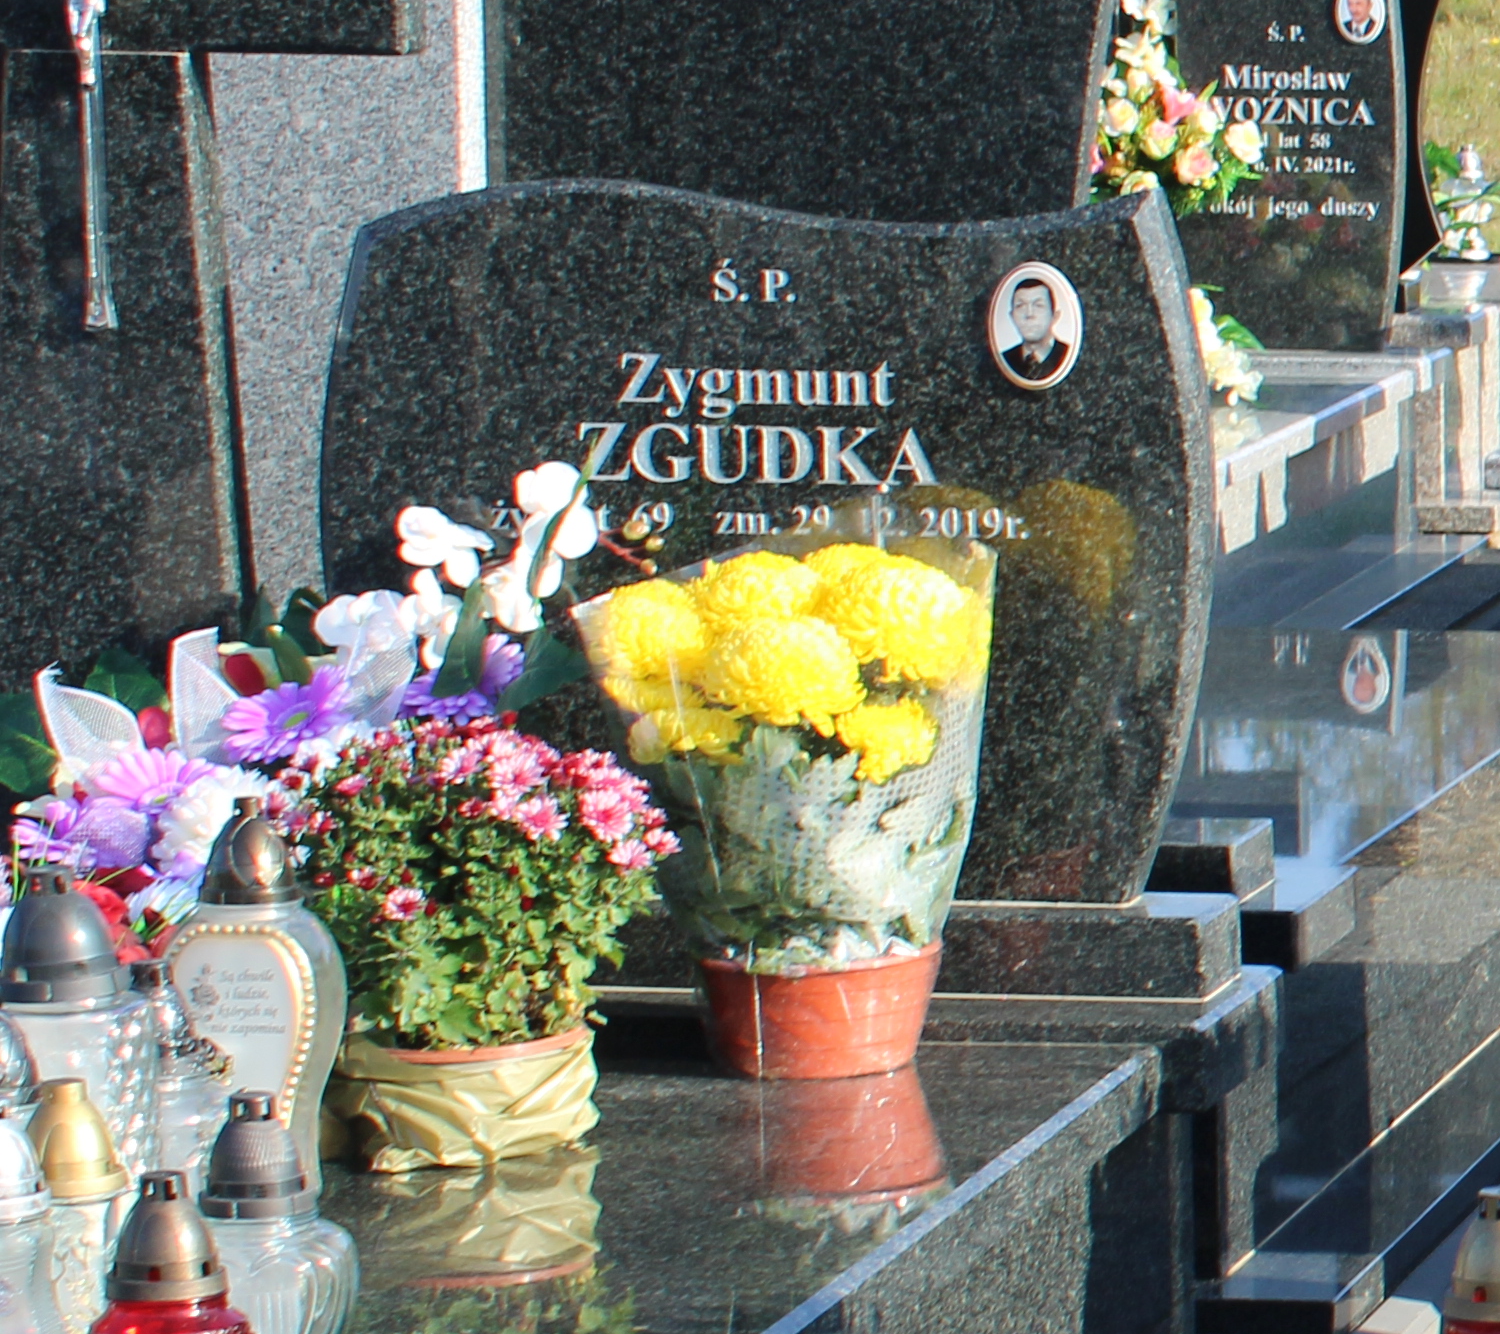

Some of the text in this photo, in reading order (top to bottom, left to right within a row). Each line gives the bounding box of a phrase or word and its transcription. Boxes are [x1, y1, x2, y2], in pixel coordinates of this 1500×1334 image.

[1289, 25, 1306, 43] P.
[1222, 64, 1351, 91] Mirosław
[1279, 132, 1302, 149] lat
[1309, 132, 1332, 149] 58
[1274, 156, 1299, 173] IV.
[1304, 157, 1356, 174] 2021r.
[1196, 195, 1380, 221] okój jego duszy
[711, 258, 796, 304] Ś. P.
[617, 351, 896, 418] Zygmunt
[576, 421, 940, 486] ZGUDKA
[631, 501, 675, 533] 69
[715, 510, 782, 535] zm.
[918, 507, 1031, 539] 2019r.
